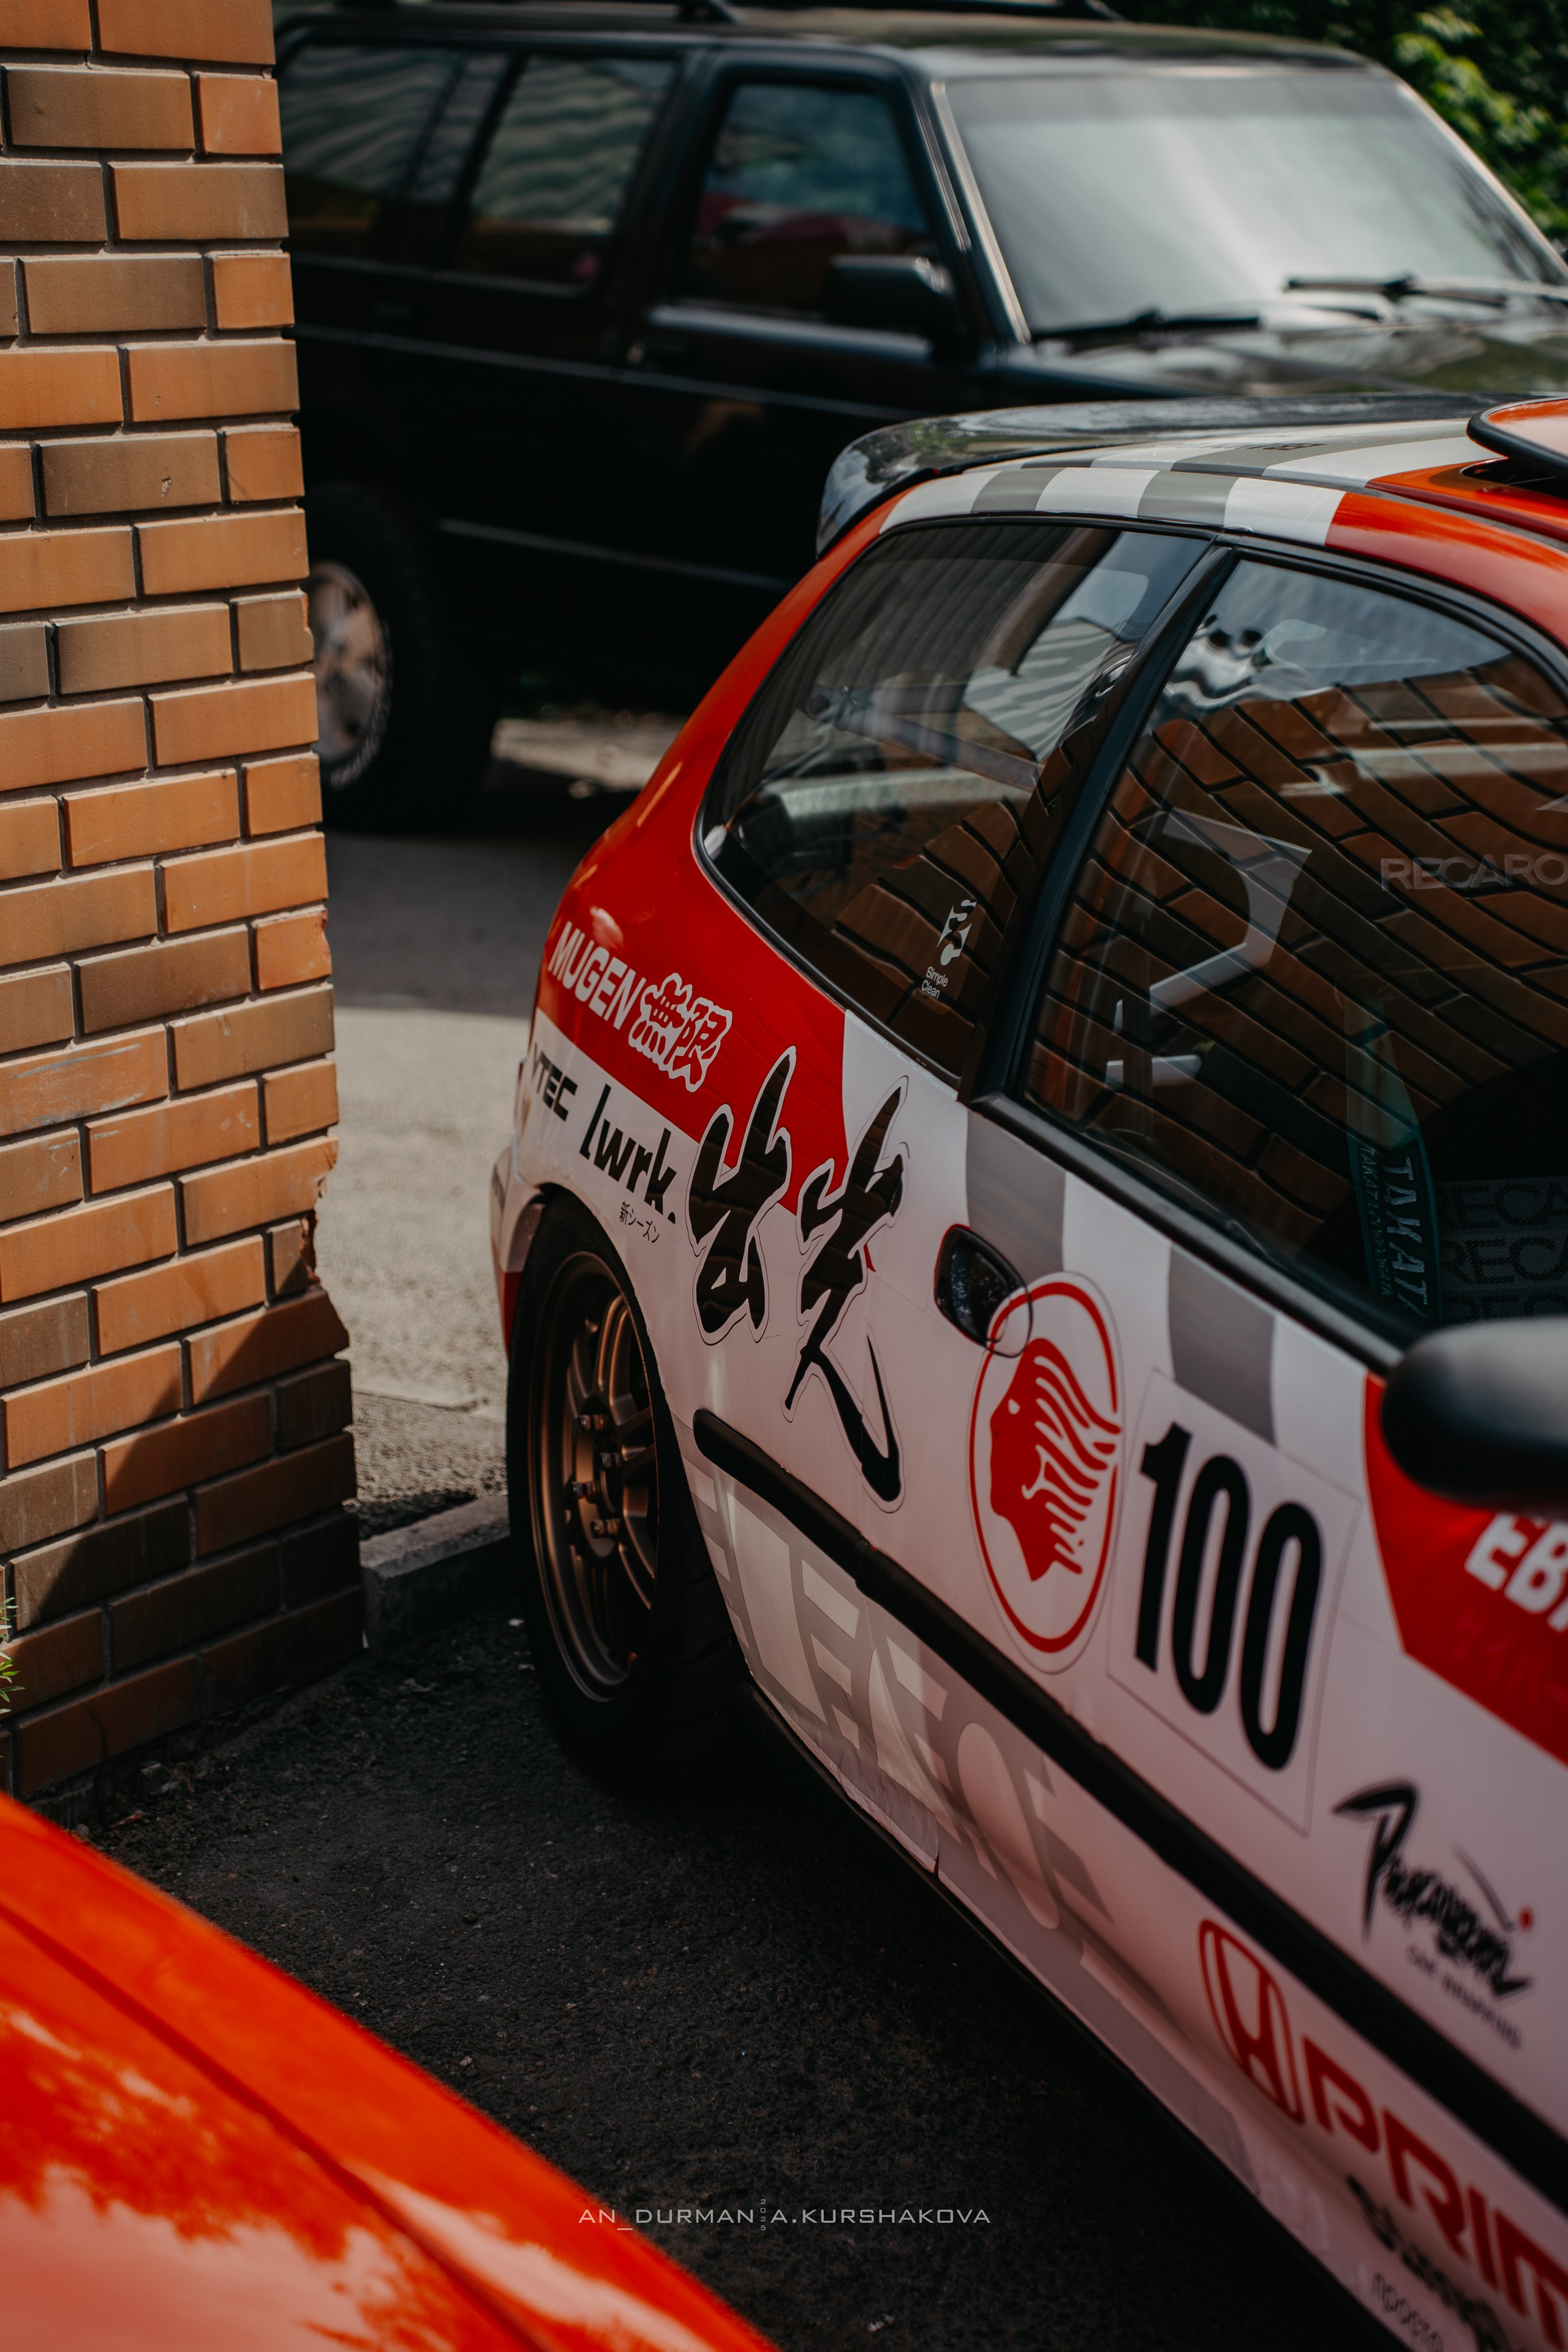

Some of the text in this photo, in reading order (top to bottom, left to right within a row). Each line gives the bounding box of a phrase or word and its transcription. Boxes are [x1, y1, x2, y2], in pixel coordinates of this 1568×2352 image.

[1380, 853, 1568, 891] RECARO
[547, 921, 647, 1031] MUGEN
[921, 980, 940, 999] Clean
[926, 966, 948, 987] Simple
[1135, 1421, 1323, 1772] 100
